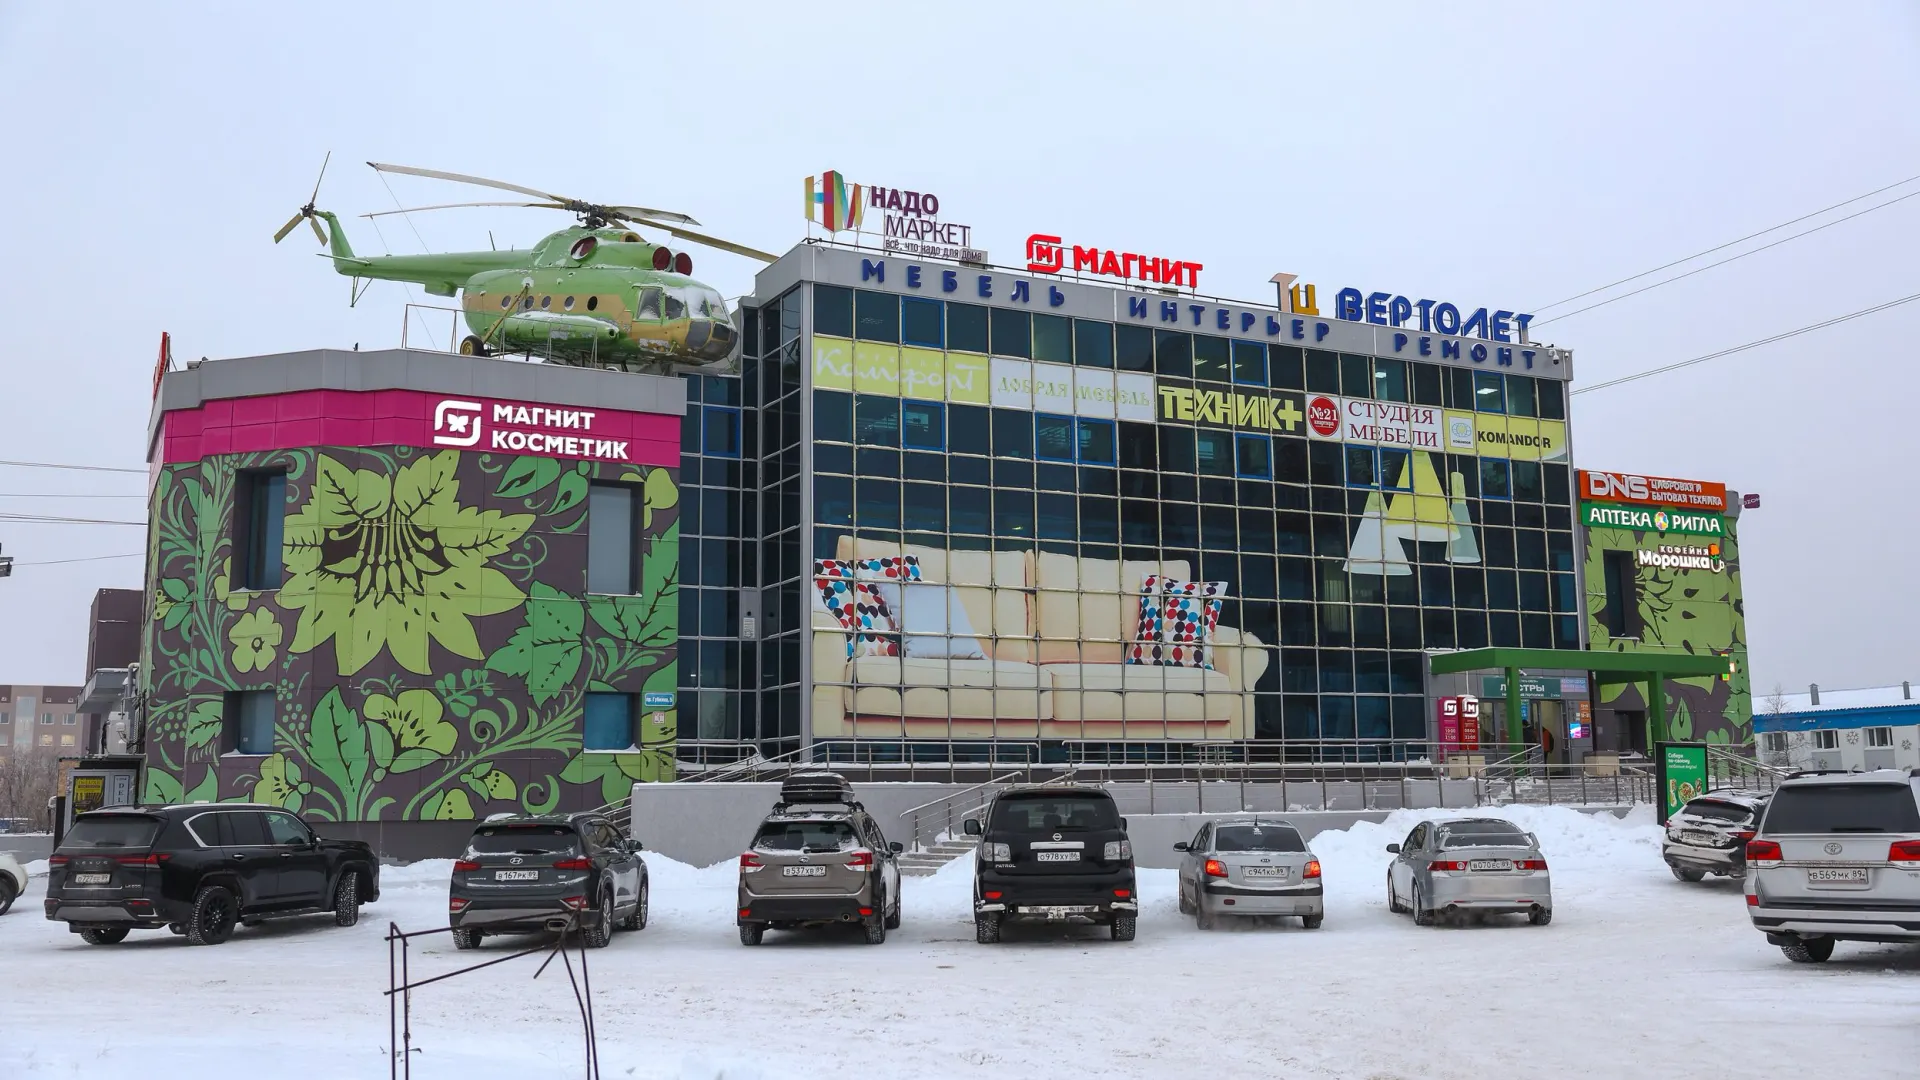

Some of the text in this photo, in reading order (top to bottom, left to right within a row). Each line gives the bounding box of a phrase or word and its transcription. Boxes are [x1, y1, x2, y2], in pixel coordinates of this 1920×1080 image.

[871, 186, 939, 218] НАДО
[886, 215, 971, 247] МАРКЕТ
[904, 243, 919, 252] что
[921, 245, 940, 256] надо
[943, 248, 959, 258] для
[962, 249, 982, 262] дома
[1073, 245, 1203, 289] МАГНИТ
[862, 258, 1536, 369] МЕБЕЛЬ ИНТЕРЬЕР РЕМОНТ
[1269, 273, 1535, 345] ТЦ ВЕРТОЛЕТ
[997, 376, 1069, 398] ДОБРАЯ
[493, 404, 595, 430] МАГНИТ
[1310, 406, 1338, 421] №21
[1348, 401, 1435, 425] СТУДИЯ
[492, 430, 629, 460] КОСМЕТИК
[1349, 424, 1438, 447] МЕБЕЛИ
[1477, 430, 1551, 448] KOMANDOR
[1587, 471, 1649, 500] DNS
[1650, 478, 1702, 493] ЦИФРОВАЯ И
[1651, 489, 1723, 506] БЫТОВАЯ ТЕХНИКА
[1589, 507, 1722, 533] АПТЕКА РИГЛА
[1638, 550, 1711, 571] Морошка
[1659, 544, 1709, 556] КОФЕЙНЯ
[1500, 683, 1545, 692] ЛСТРЫ
